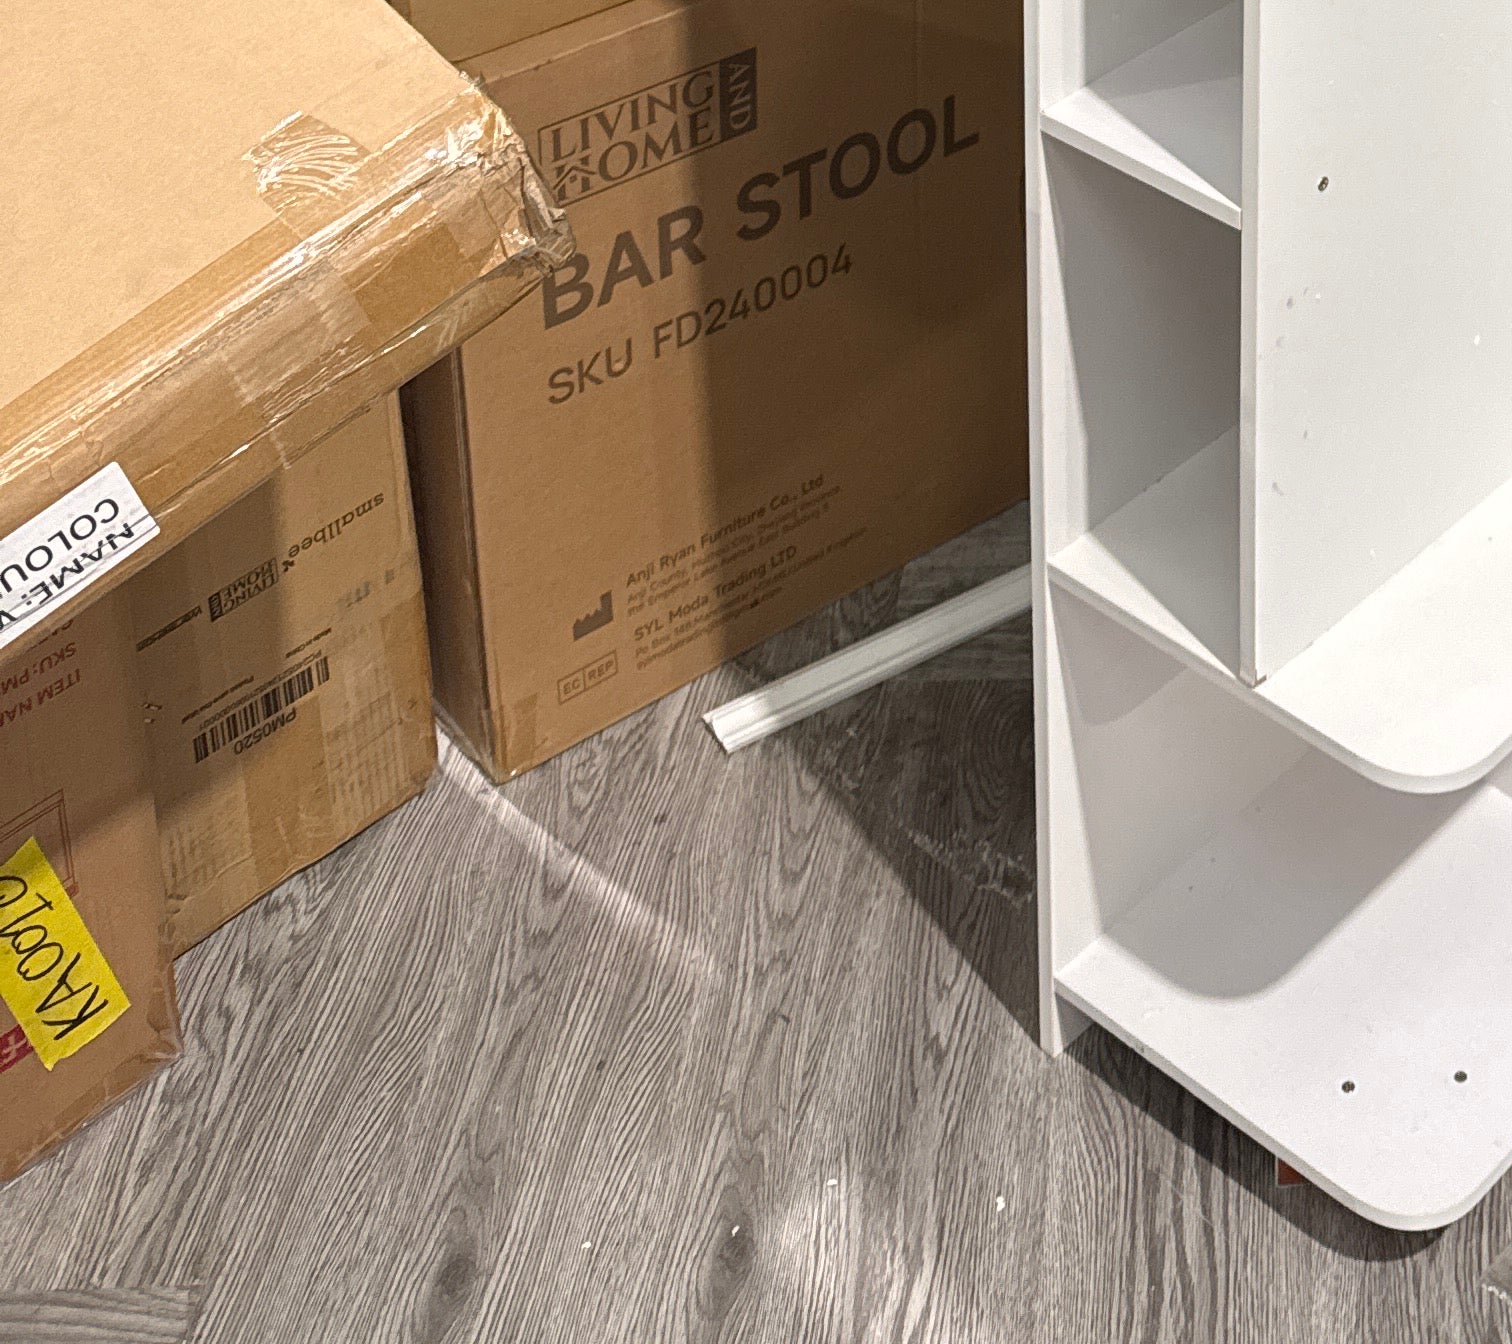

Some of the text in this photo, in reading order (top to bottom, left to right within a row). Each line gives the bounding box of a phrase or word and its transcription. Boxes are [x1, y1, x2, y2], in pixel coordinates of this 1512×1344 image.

[551, 70, 715, 163] LIVING
[727, 62, 752, 131] AND
[542, 94, 980, 330] BAR STOOL
[548, 242, 853, 405] SKU FD240004
[21, 522, 134, 607] NAME:
[288, 493, 385, 558] smallbee
[233, 707, 297, 755] PM0520
